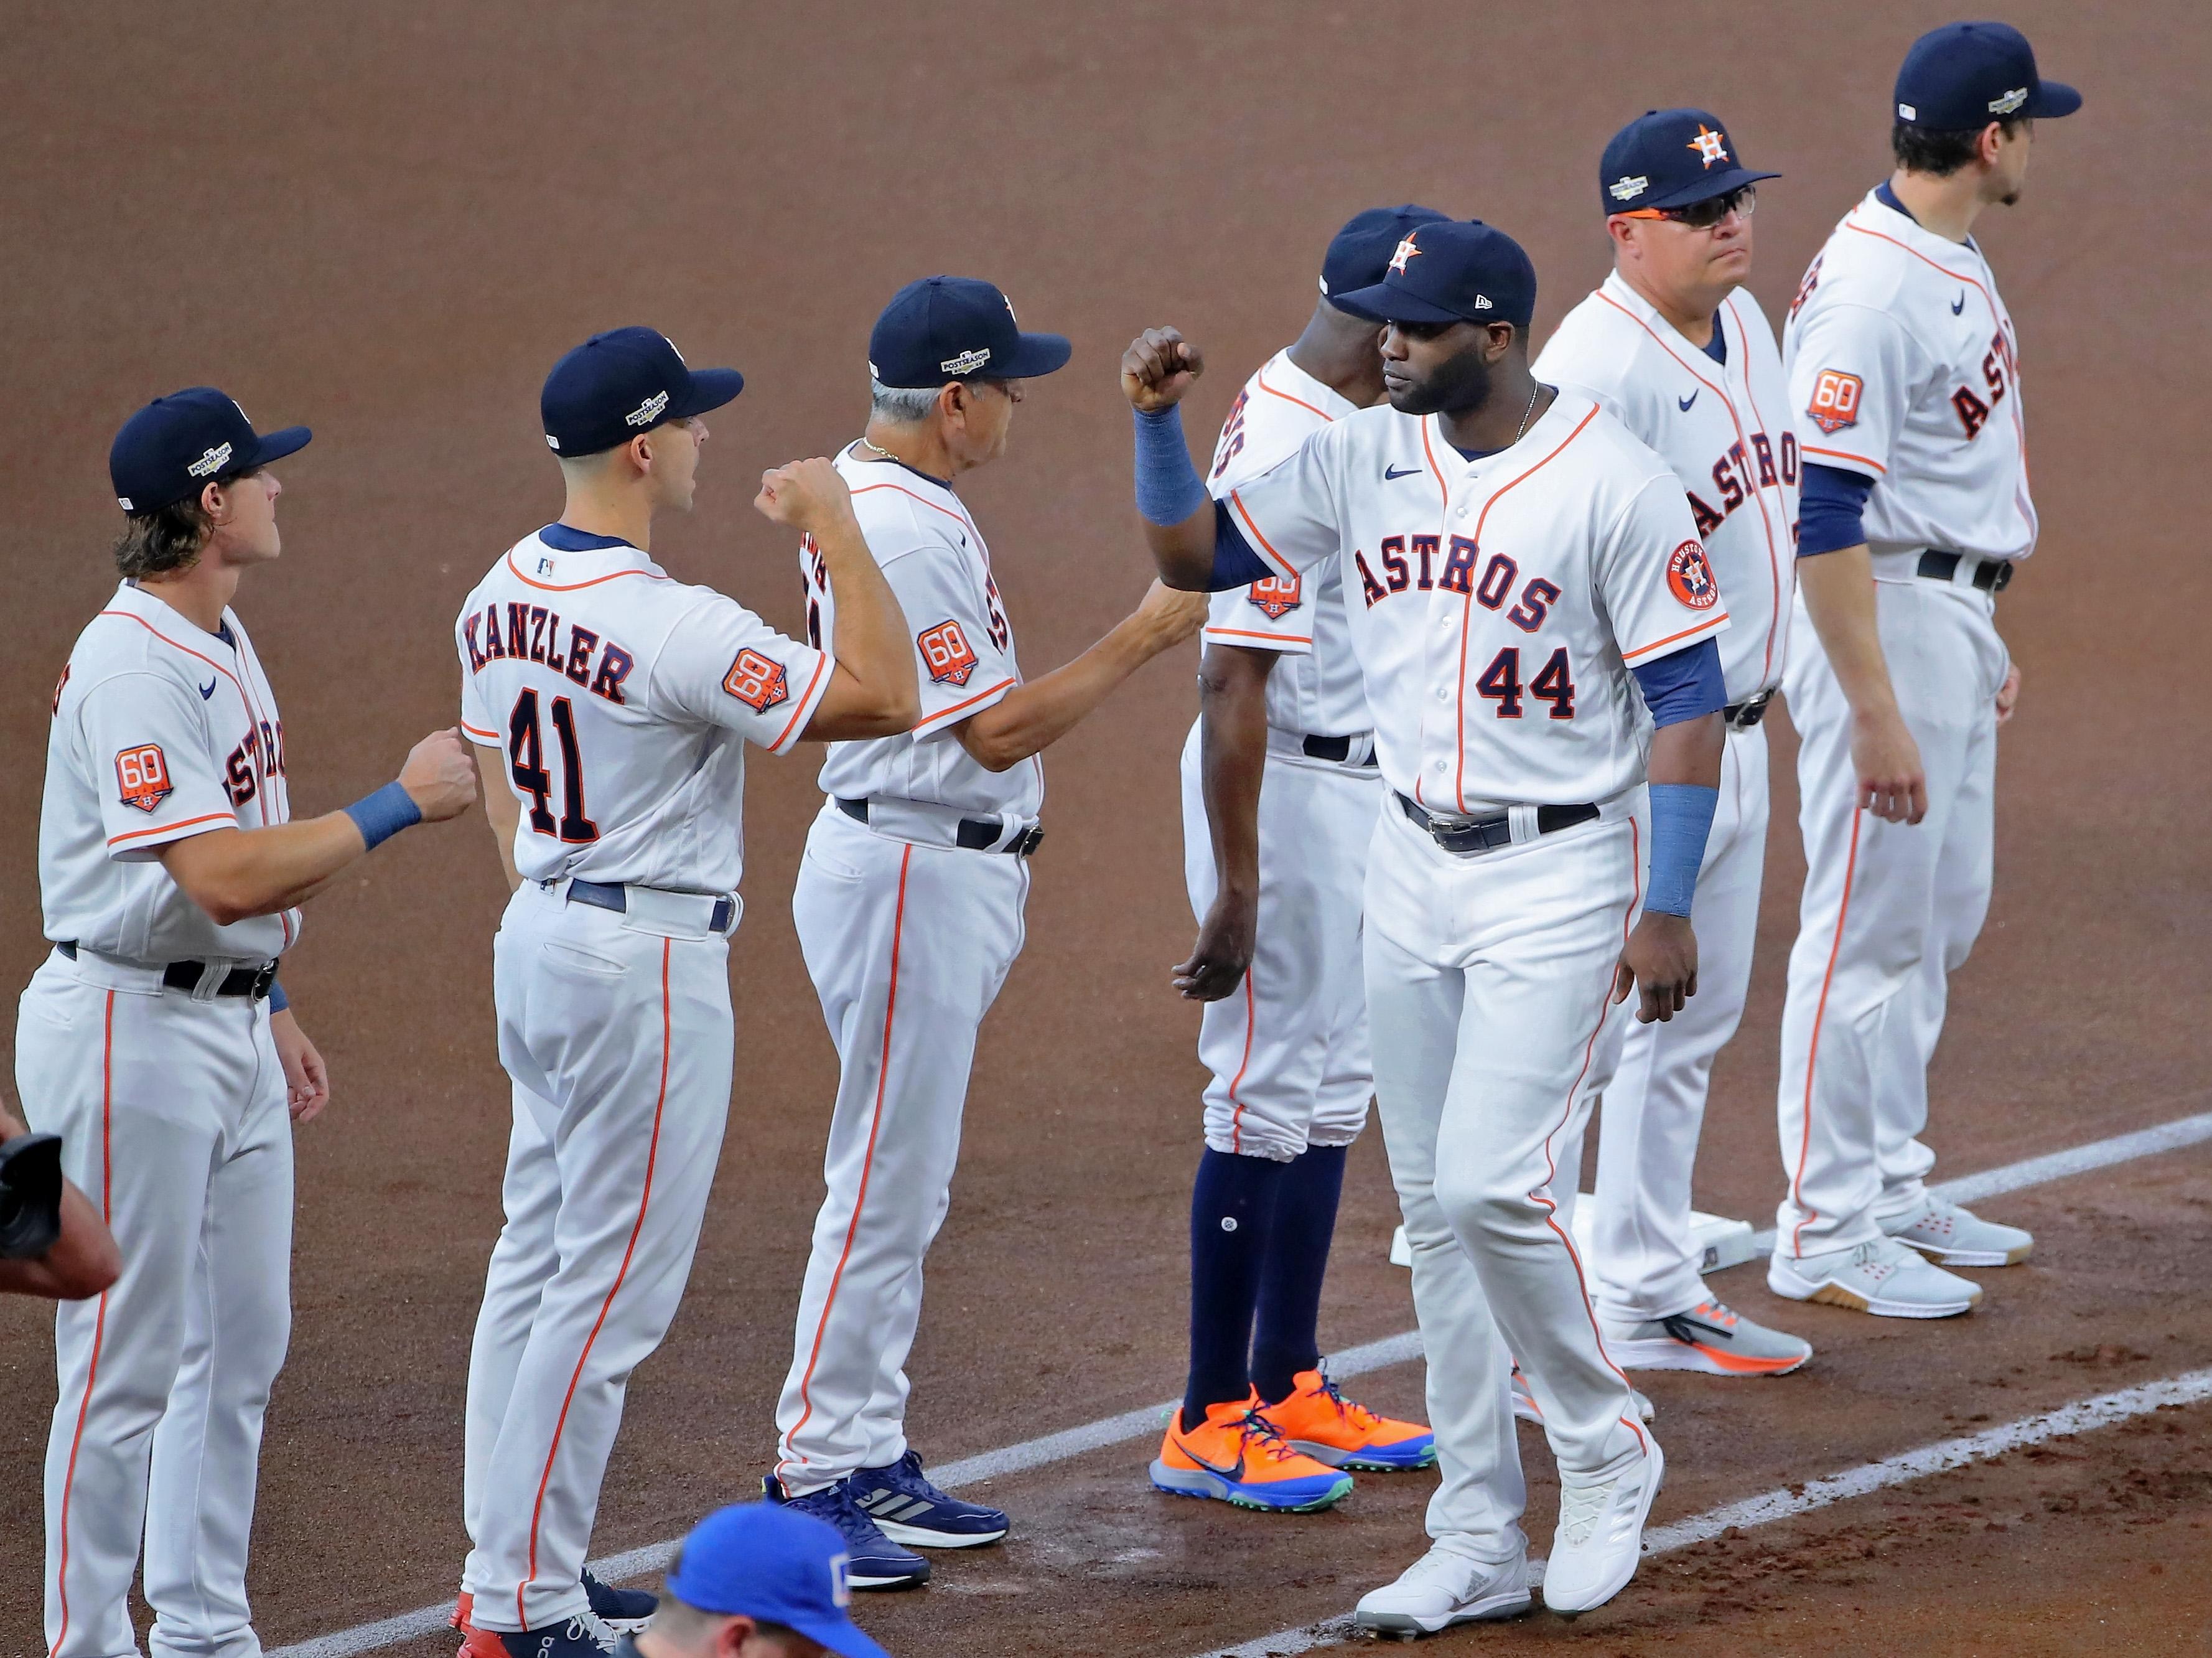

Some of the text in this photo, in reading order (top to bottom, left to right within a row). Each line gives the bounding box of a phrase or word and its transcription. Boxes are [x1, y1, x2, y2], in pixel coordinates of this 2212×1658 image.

[1693, 131, 1728, 164] H
[1389, 240, 1417, 270] H
[944, 352, 988, 370] POSTSEASON
[628, 394, 666, 423] POSTSEASON
[1816, 375, 1857, 412] 60
[191, 445, 230, 473] POSTSEASON
[1686, 431, 1803, 540] ASTRO
[1671, 543, 1703, 572] HOUSTON
[1355, 533, 1562, 633] ASTROS
[1689, 582, 1716, 606] ASTROS
[464, 602, 634, 705] KANZLER
[923, 625, 967, 667] 60
[729, 653, 772, 699] 60
[1475, 647, 1575, 719] 44
[120, 749, 162, 789] 60
[508, 687, 600, 843] 41
